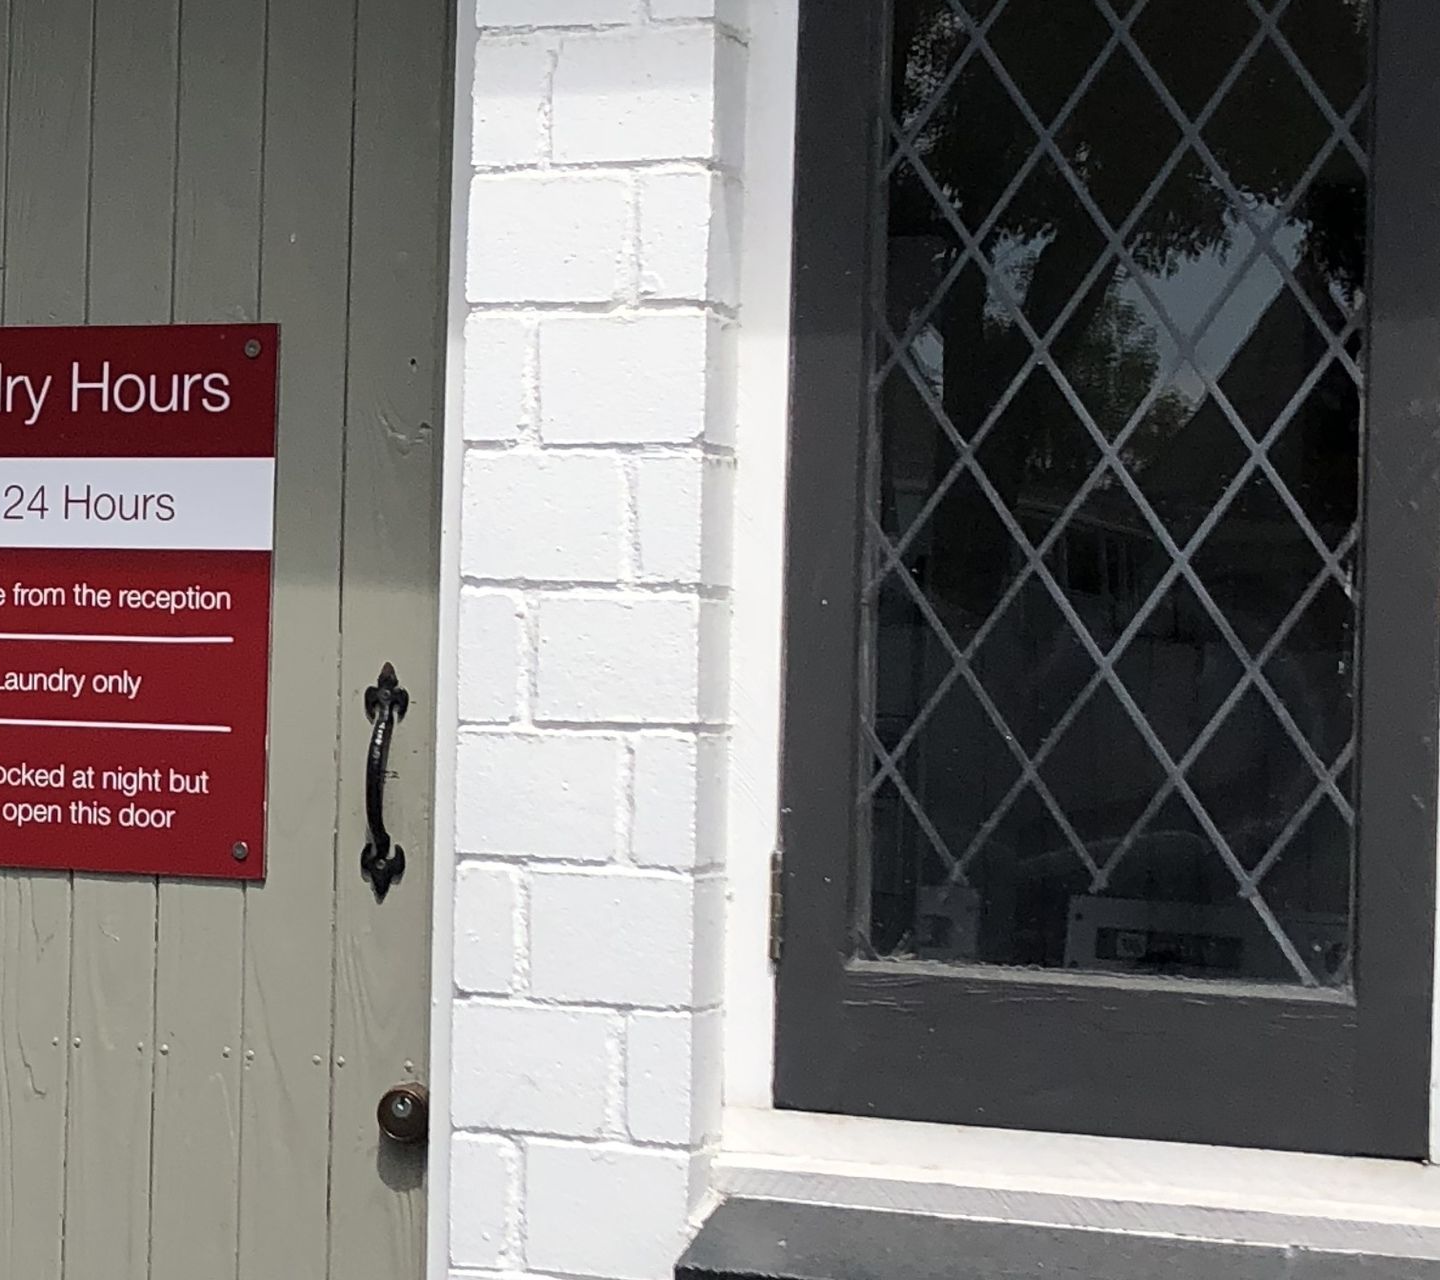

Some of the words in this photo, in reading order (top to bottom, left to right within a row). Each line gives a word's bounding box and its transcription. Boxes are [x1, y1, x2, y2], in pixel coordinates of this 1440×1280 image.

[71, 361, 231, 413] Hours
[3, 484, 49, 520] 24
[64, 484, 175, 522] Hours
[12, 582, 66, 607] from
[72, 582, 112, 608] the
[118, 585, 231, 615] reception
[92, 669, 142, 700] only
[71, 766, 95, 789] at
[102, 765, 162, 797] night
[169, 767, 210, 794] but
[2, 802, 62, 827] open
[68, 800, 112, 826] this
[118, 802, 176, 828] door
